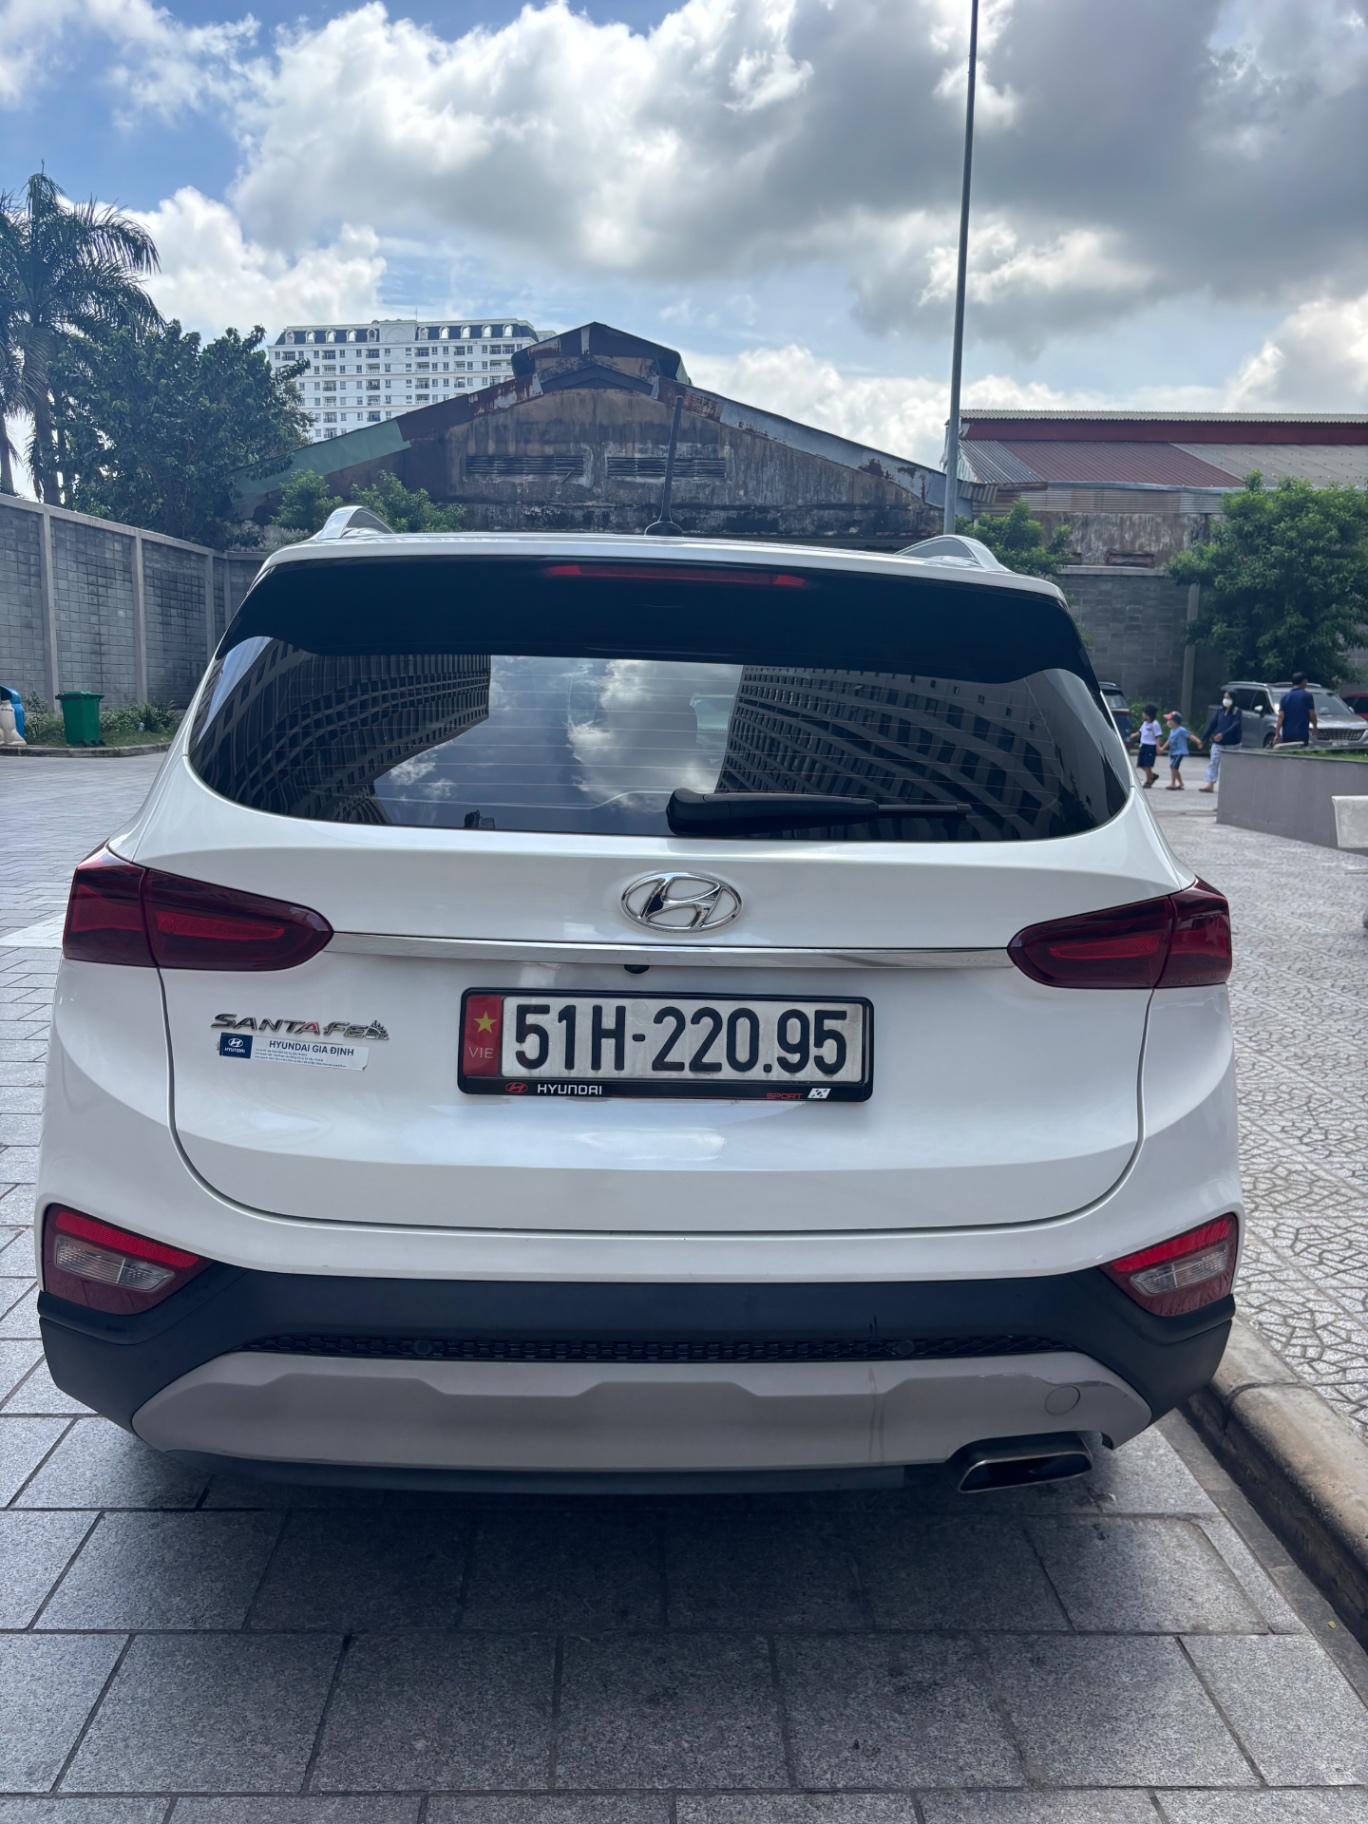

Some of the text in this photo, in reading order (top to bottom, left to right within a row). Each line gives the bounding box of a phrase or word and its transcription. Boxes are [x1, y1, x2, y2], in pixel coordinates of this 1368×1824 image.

[514, 1004, 848, 1075] 51H-220.95
[269, 1040, 310, 1052] HYUNDAI
[312, 1044, 328, 1054] GIA
[330, 1046, 355, 1057] ĐỊNH
[468, 1046, 494, 1059] VIE
[537, 1084, 602, 1095] HYUNDAI
[766, 1092, 802, 1100] SPORT
